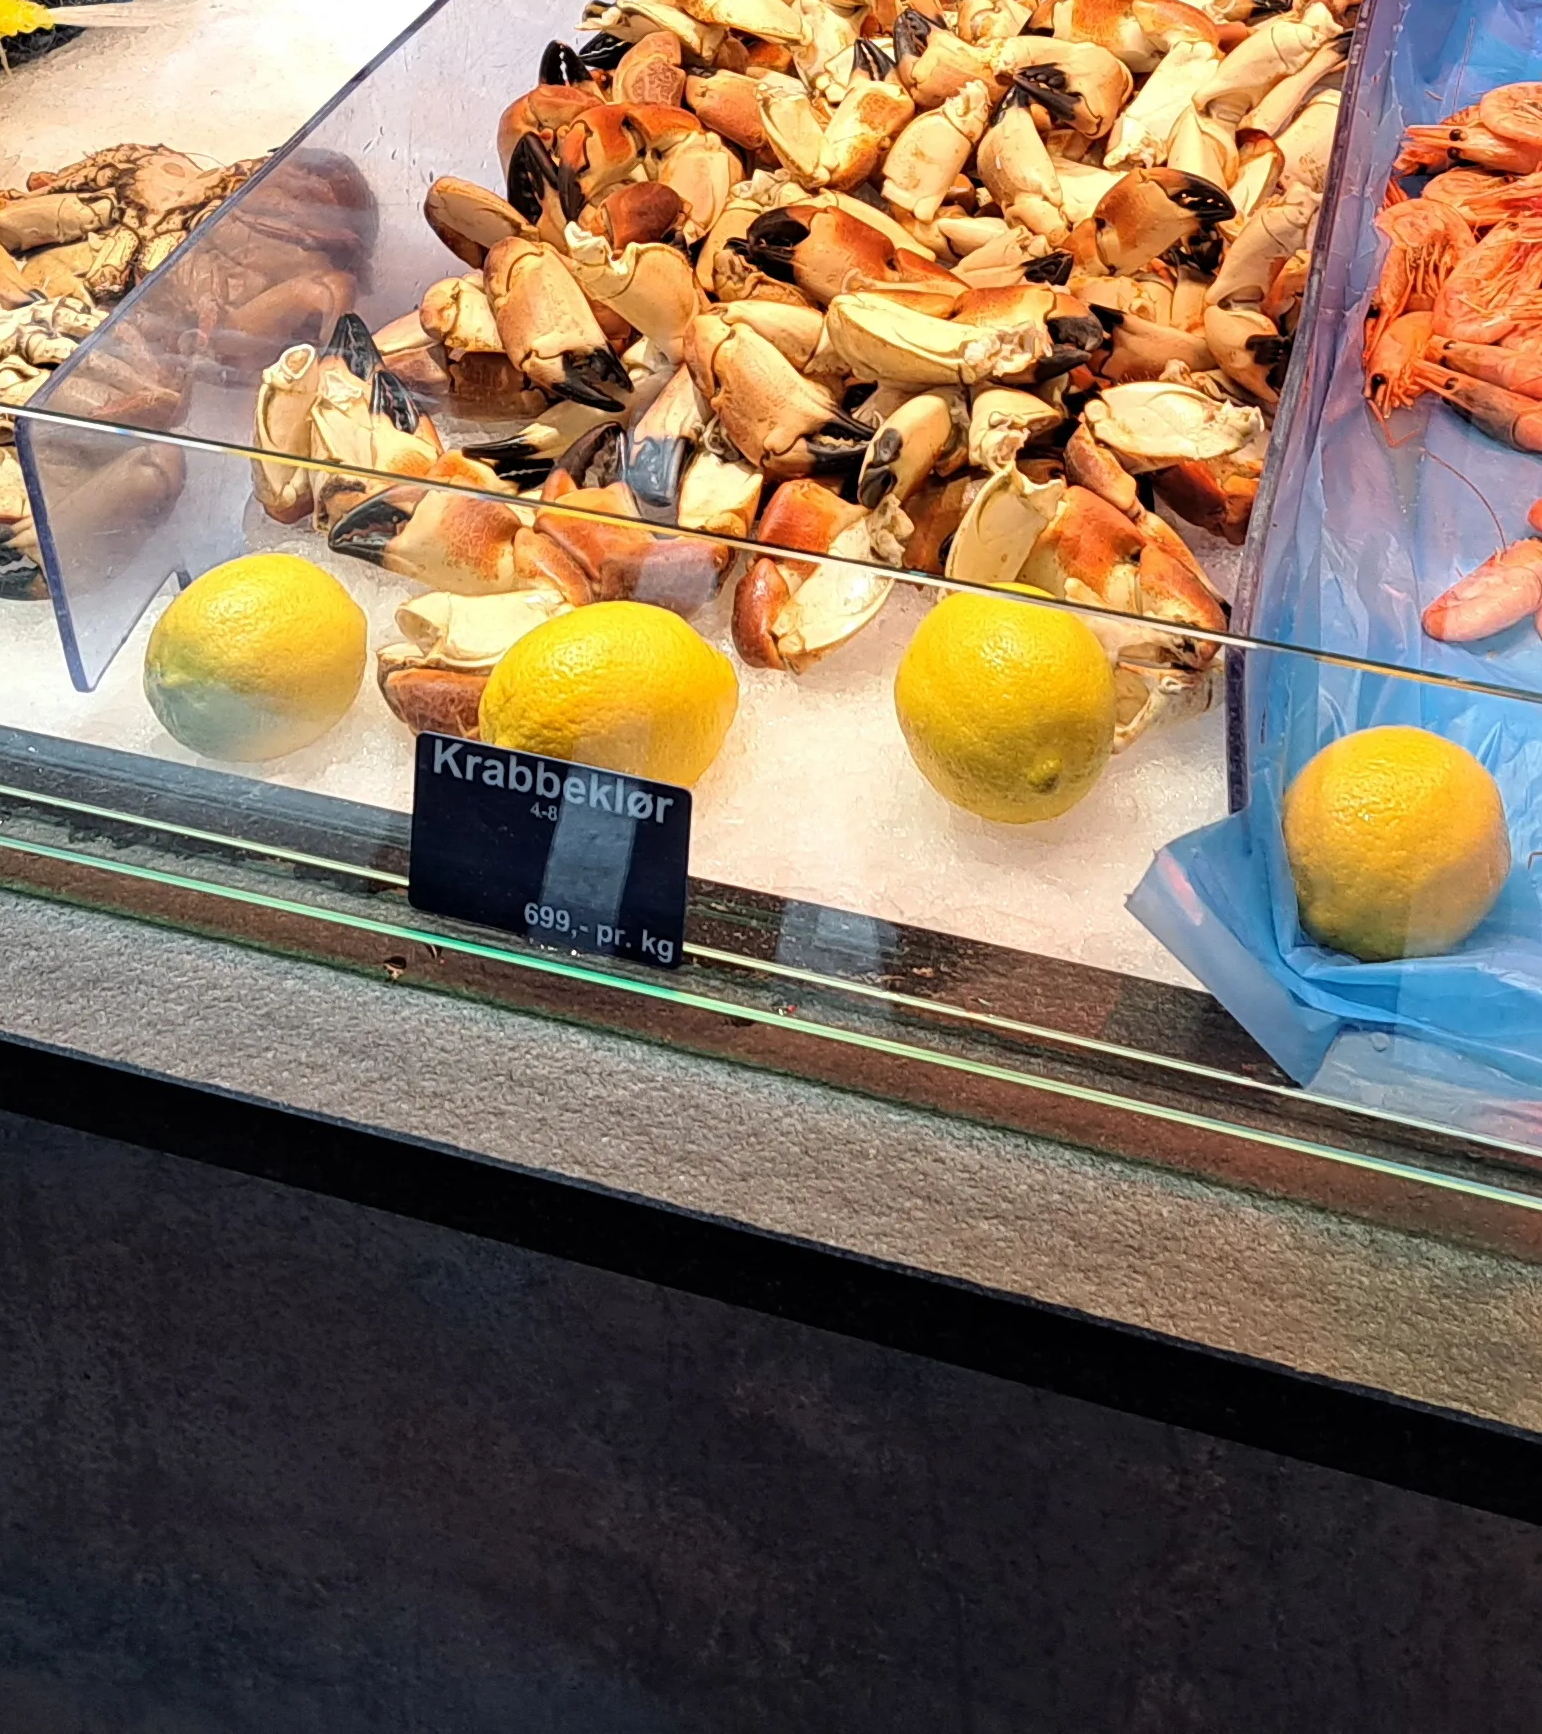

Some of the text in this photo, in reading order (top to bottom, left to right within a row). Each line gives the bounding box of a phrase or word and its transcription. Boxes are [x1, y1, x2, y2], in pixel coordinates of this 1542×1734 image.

[432, 738, 674, 824] Krabbeklør
[529, 801, 558, 822] 4-8
[524, 901, 674, 964] 699,- pr. kg
